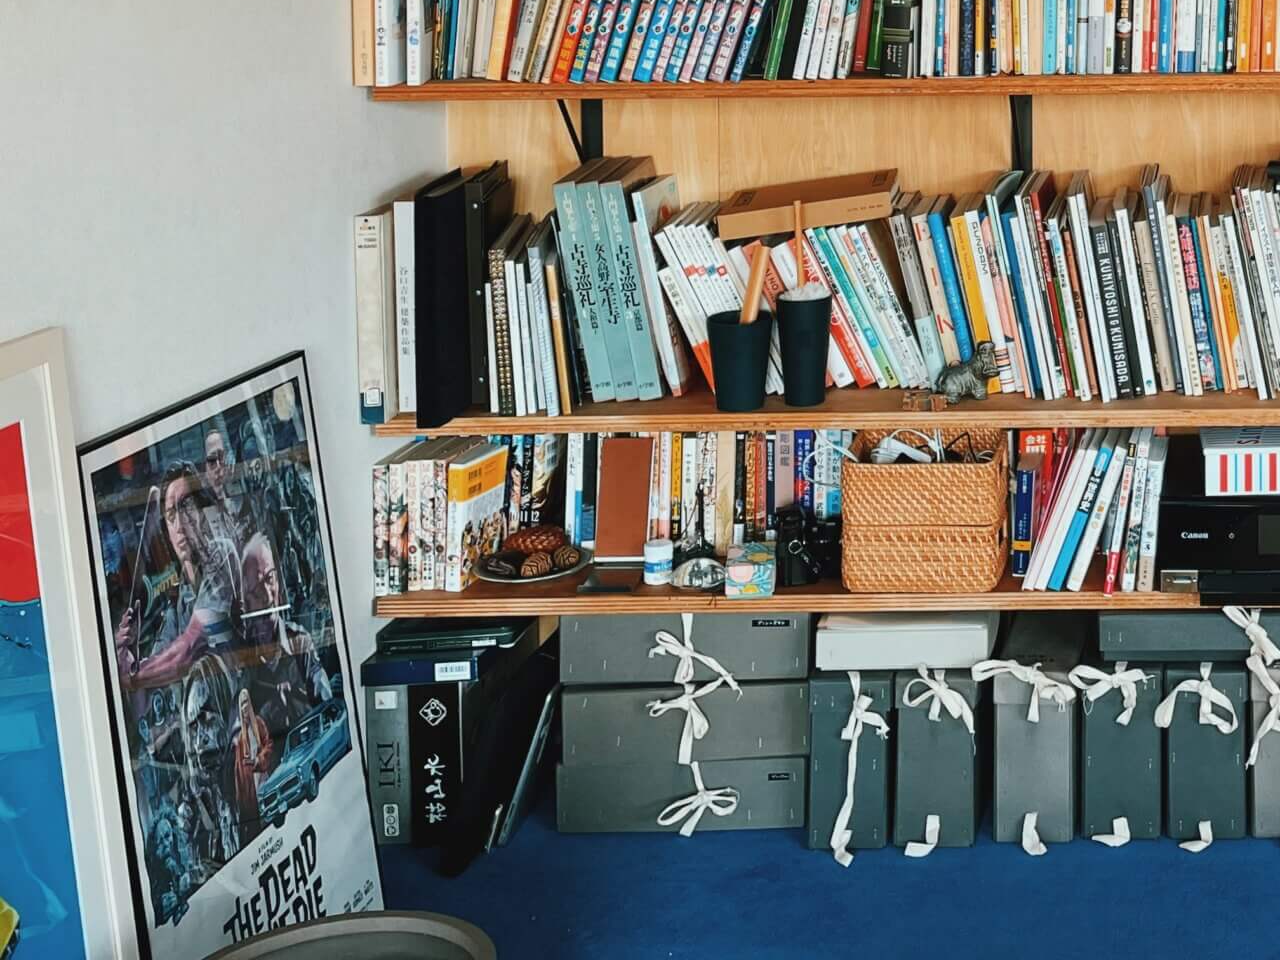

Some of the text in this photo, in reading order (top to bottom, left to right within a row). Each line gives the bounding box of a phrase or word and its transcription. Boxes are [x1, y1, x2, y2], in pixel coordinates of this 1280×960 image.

[569, 243, 596, 308] 古寺巡礼
[615, 244, 641, 309] 古寺巡礼
[1105, 257, 1120, 320] KUNIYOSHI
[1181, 531, 1209, 539] Canon
[223, 896, 264, 944] THE
[259, 824, 317, 921] DEAD
